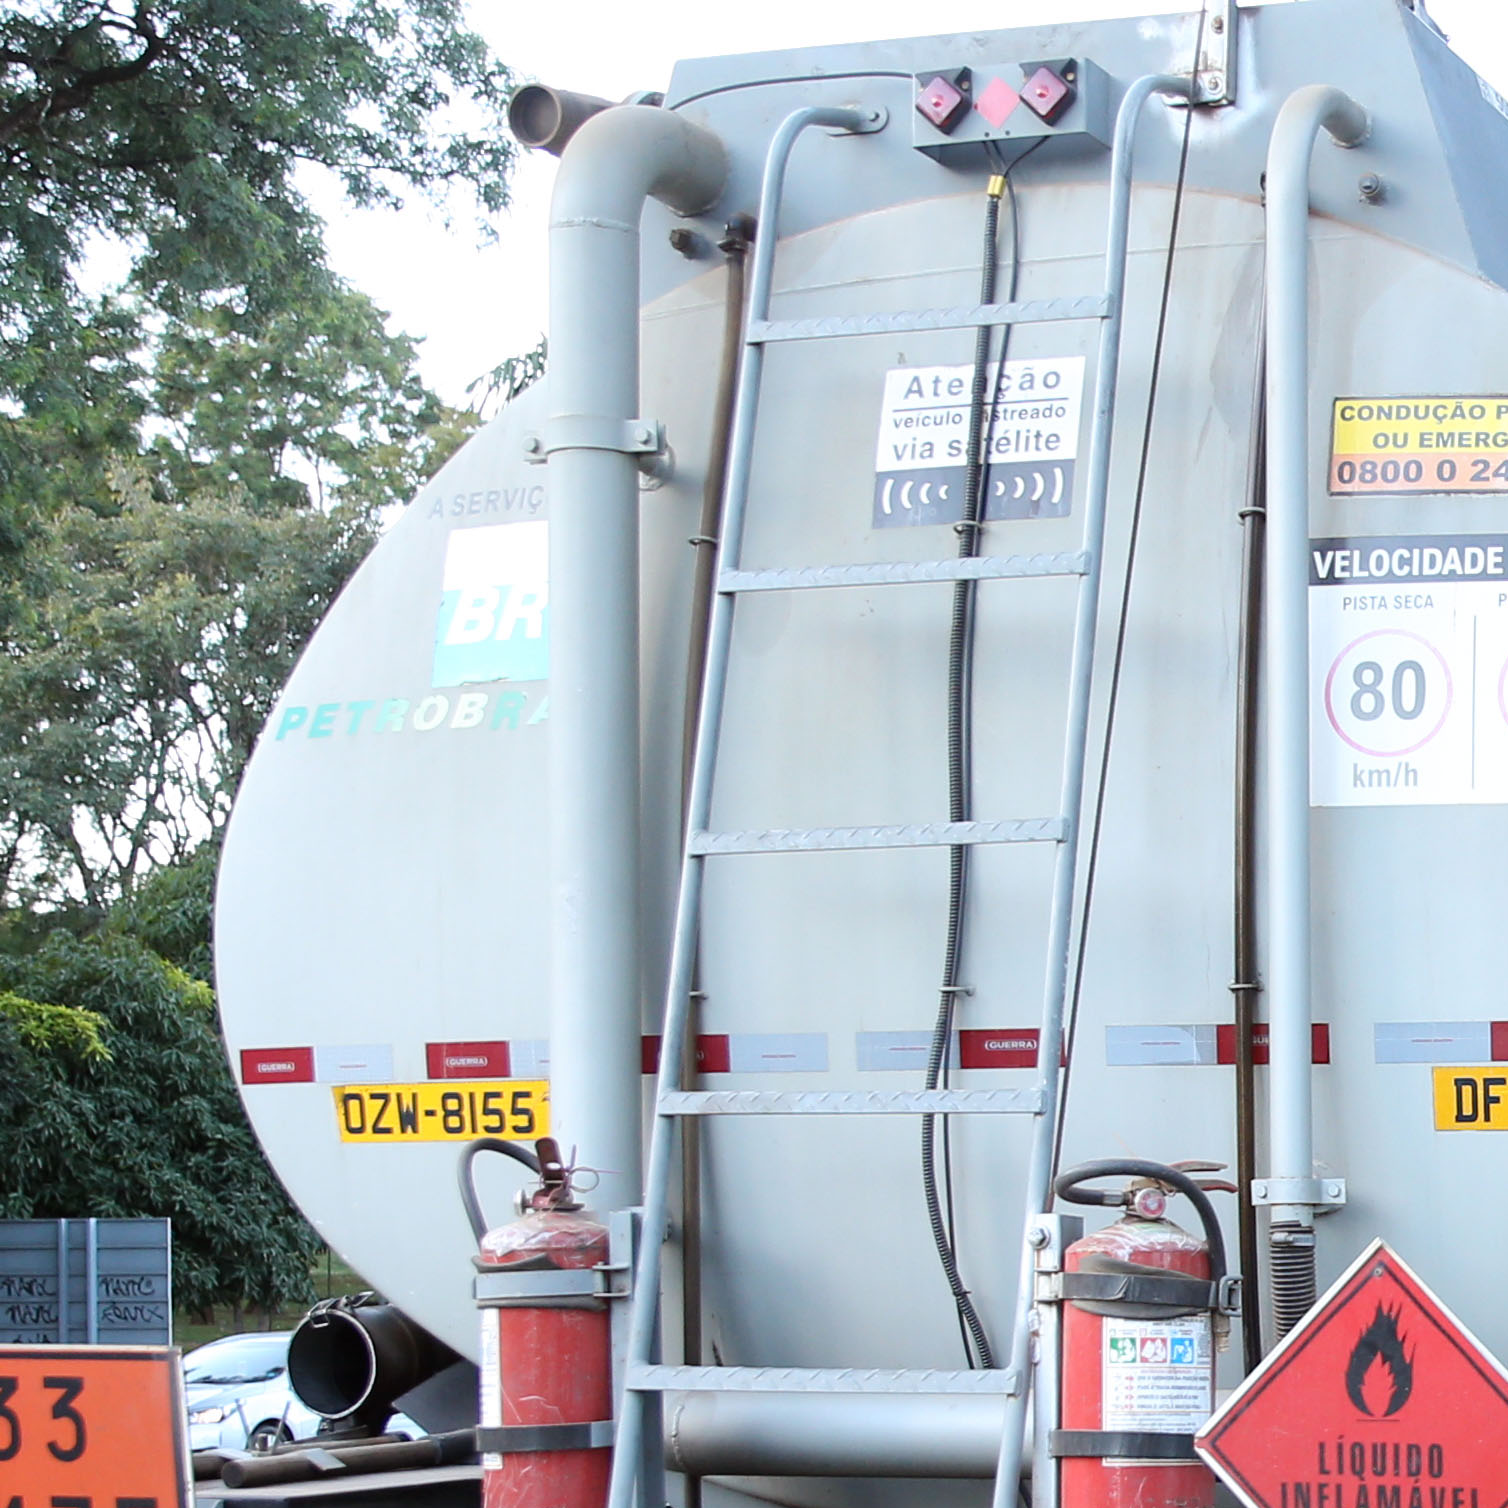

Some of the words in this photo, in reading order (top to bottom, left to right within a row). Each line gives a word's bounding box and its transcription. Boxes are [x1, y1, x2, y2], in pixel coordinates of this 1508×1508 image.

[904, 367, 1061, 400] Ateção
[893, 410, 963, 428] veículo
[1340, 402, 1486, 426] CONDUÇÃO
[893, 437, 935, 461] via
[1372, 432, 1409, 449] OU
[1337, 459, 1422, 485] 0800
[1436, 459, 1457, 482] 0
[427, 500, 444, 520] A
[451, 485, 545, 516] SERVIÇ
[1313, 546, 1504, 579] VELOCIDADE
[444, 584, 548, 645] BR
[1343, 595, 1388, 611] PISTA
[1393, 594, 1434, 610] SECA
[1349, 659, 1426, 722] 80
[1352, 761, 1418, 789] km/h
[343, 1091, 535, 1134] OZW-8155
[1318, 1436, 1444, 1482] LÍQUIDO
